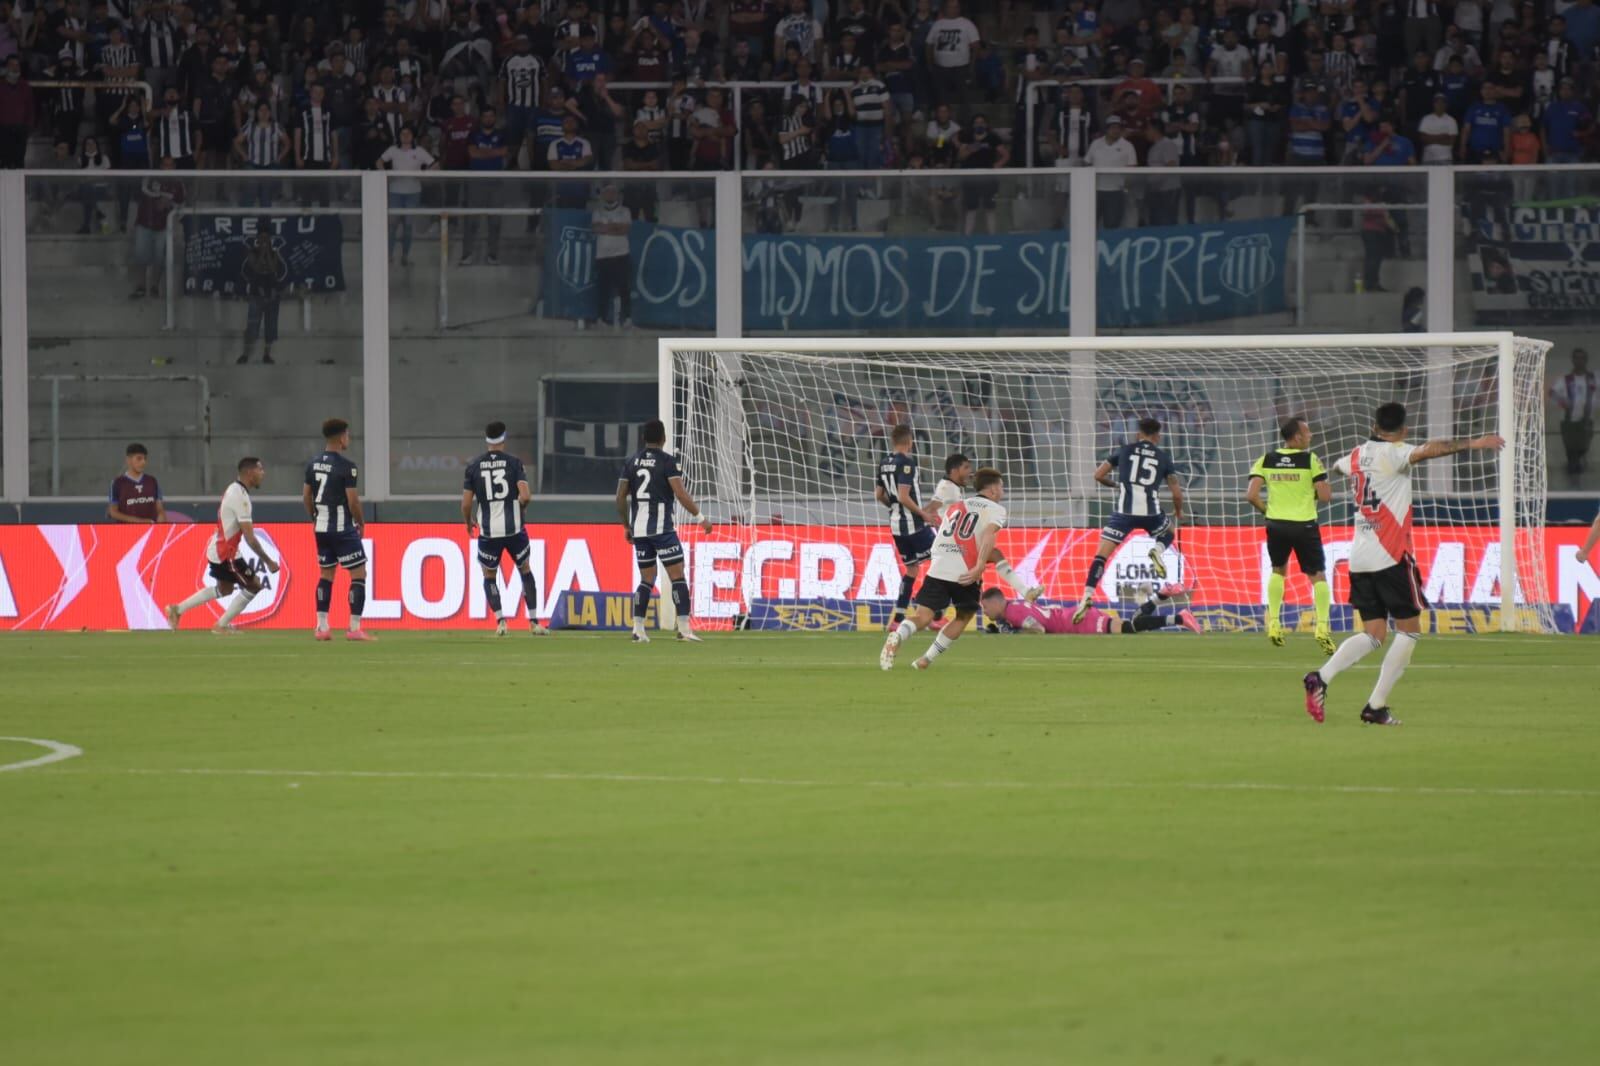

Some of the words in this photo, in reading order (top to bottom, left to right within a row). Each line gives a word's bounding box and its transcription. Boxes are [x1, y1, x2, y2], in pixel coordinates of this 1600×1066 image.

[214, 217, 315, 234] RETU
[1514, 206, 1600, 240] CHA
[186, 274, 336, 294] ARRIITO
[632, 230, 707, 308] OS
[742, 240, 912, 318] MISMOS
[925, 246, 1003, 318] DE
[553, 422, 648, 451] CU
[480, 468, 509, 500] 13
[636, 468, 651, 499] 2
[1129, 454, 1159, 486] 15
[314, 472, 328, 503] 7
[942, 509, 980, 539] 30
[361, 537, 605, 620] LOMA
[1116, 563, 1160, 579] LOM
[567, 595, 598, 626] LA
[606, 597, 660, 628] NUE
